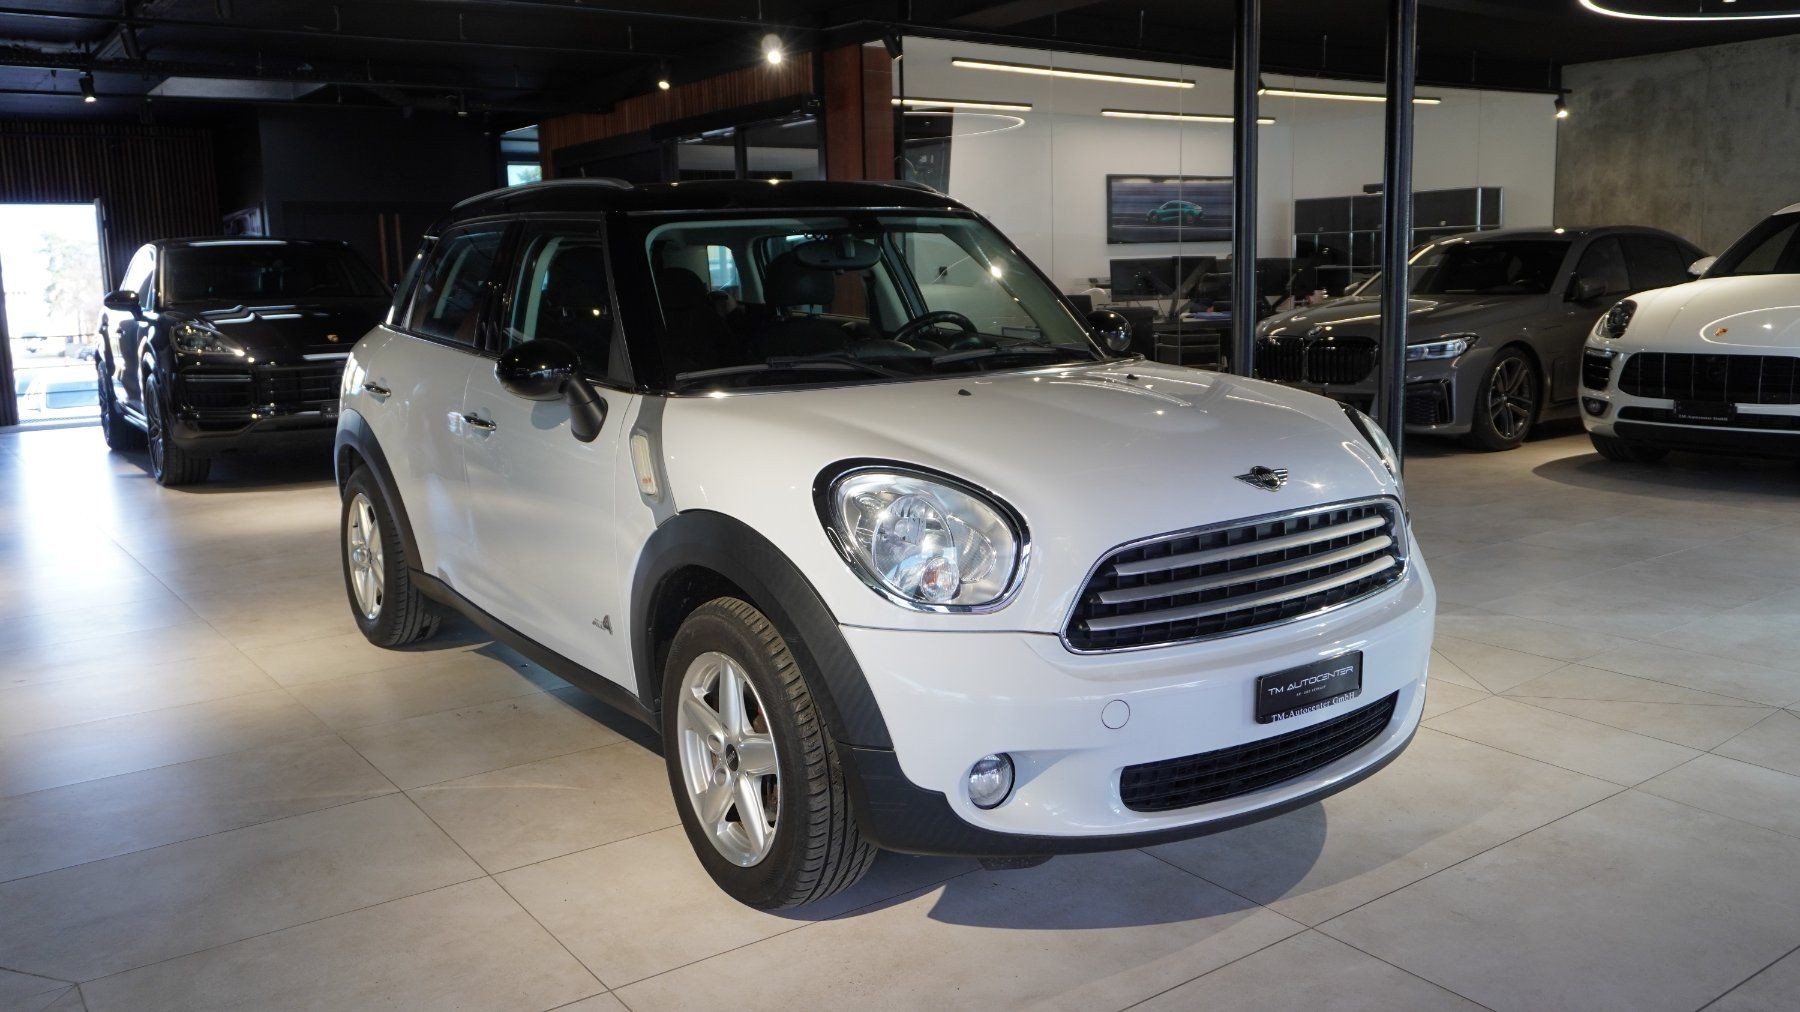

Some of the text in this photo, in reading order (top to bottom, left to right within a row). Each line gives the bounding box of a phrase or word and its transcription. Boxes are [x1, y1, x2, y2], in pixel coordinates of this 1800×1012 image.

[1267, 686, 1284, 696] TM
[1286, 665, 1354, 691] AUTOCENTER
[1271, 691, 1355, 722] TM-Autocenter GmbH
